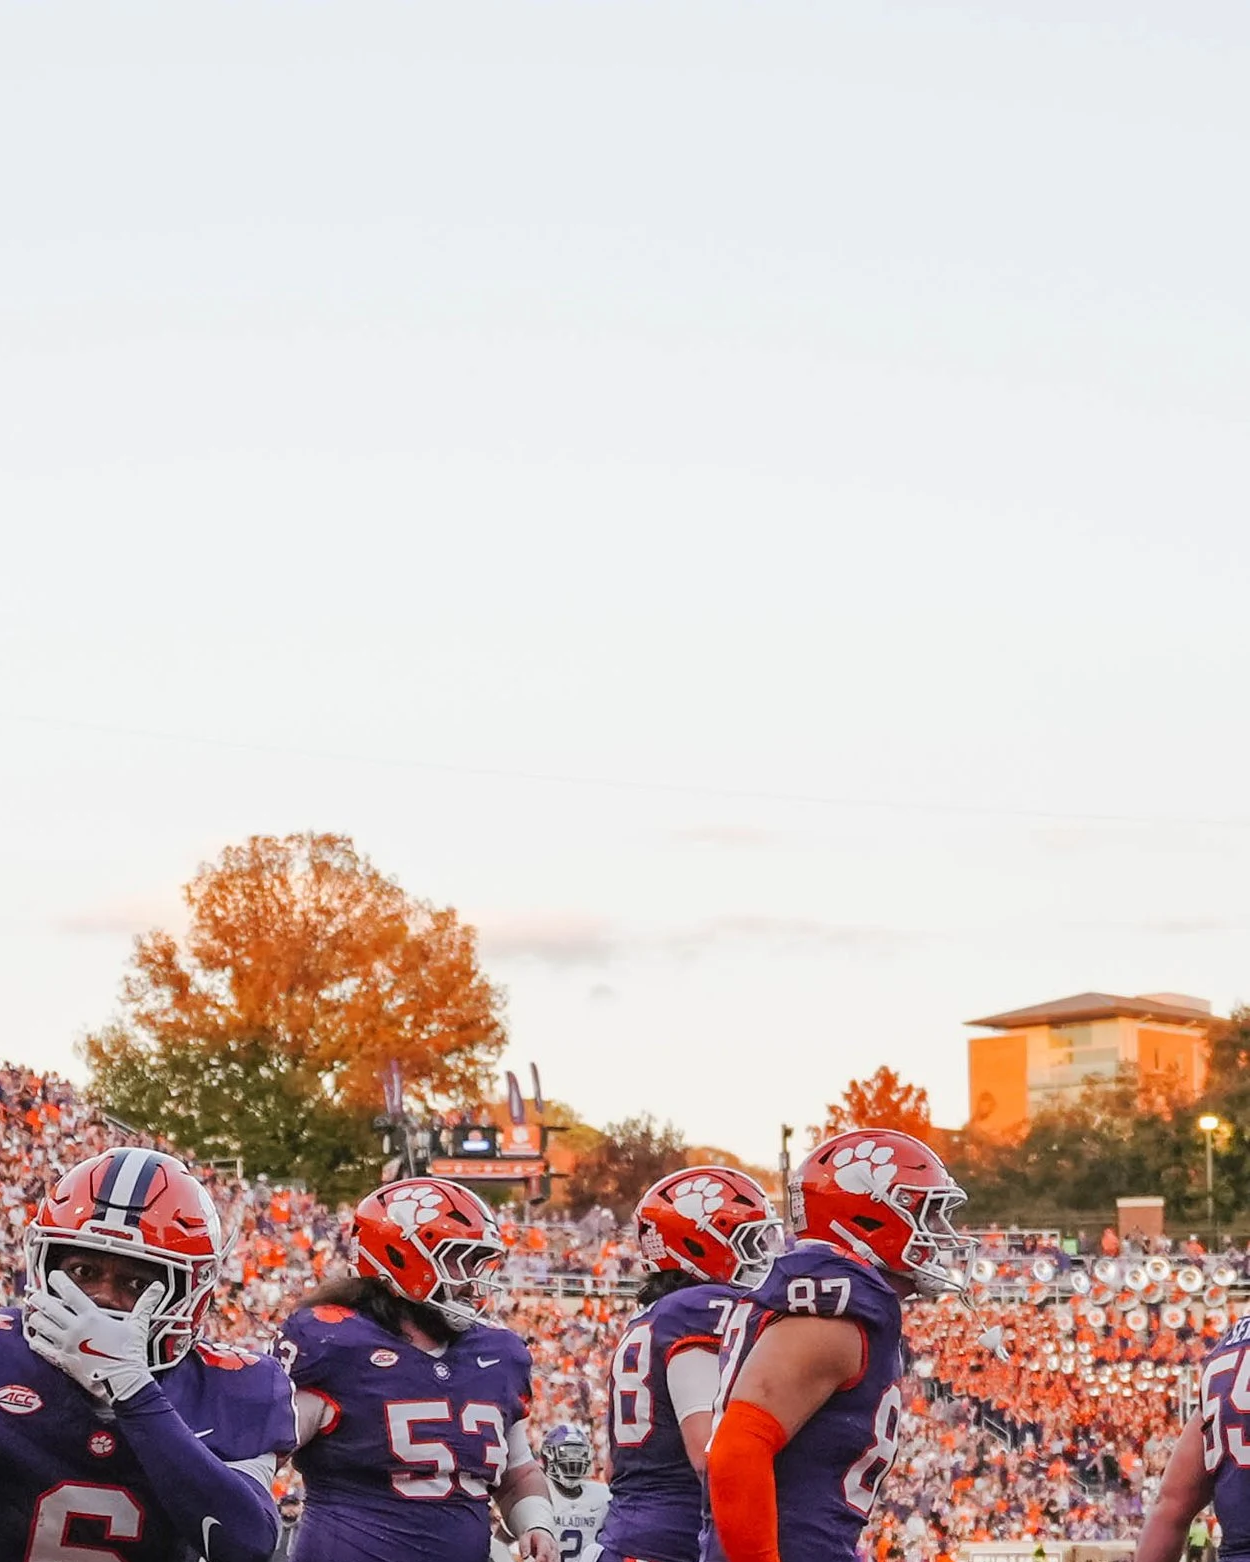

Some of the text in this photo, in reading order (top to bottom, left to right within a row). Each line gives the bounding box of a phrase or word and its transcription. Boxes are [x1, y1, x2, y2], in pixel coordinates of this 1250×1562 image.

[787, 1277, 851, 1317] 87
[707, 1300, 733, 1335] 7
[0, 1391, 37, 1407] ACC
[383, 1399, 508, 1500] 53
[553, 1515, 596, 1527] ALADINS
